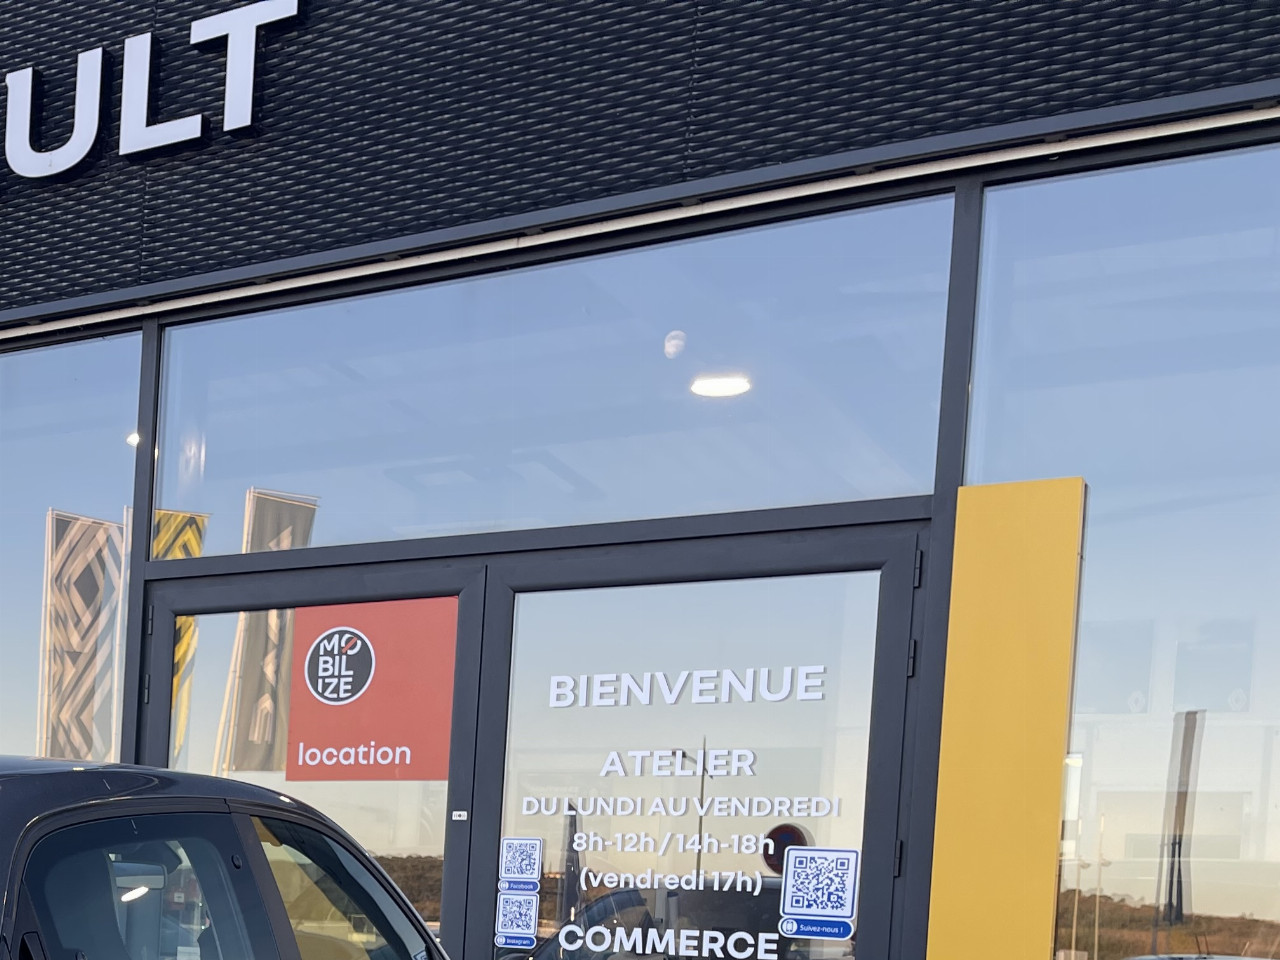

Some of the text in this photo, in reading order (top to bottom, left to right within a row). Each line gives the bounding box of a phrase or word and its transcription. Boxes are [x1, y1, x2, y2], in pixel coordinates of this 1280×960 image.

[548, 664, 826, 708] BIENVENUE
[297, 740, 412, 766] location
[598, 748, 756, 777] ATELIER
[521, 796, 840, 817] DU LUNDI AU VENDREDI
[572, 832, 654, 852] 8h-12h
[676, 833, 775, 855] 14h-18h
[578, 866, 763, 897] (vendredi 17h)
[558, 924, 780, 960] COMMERCE
